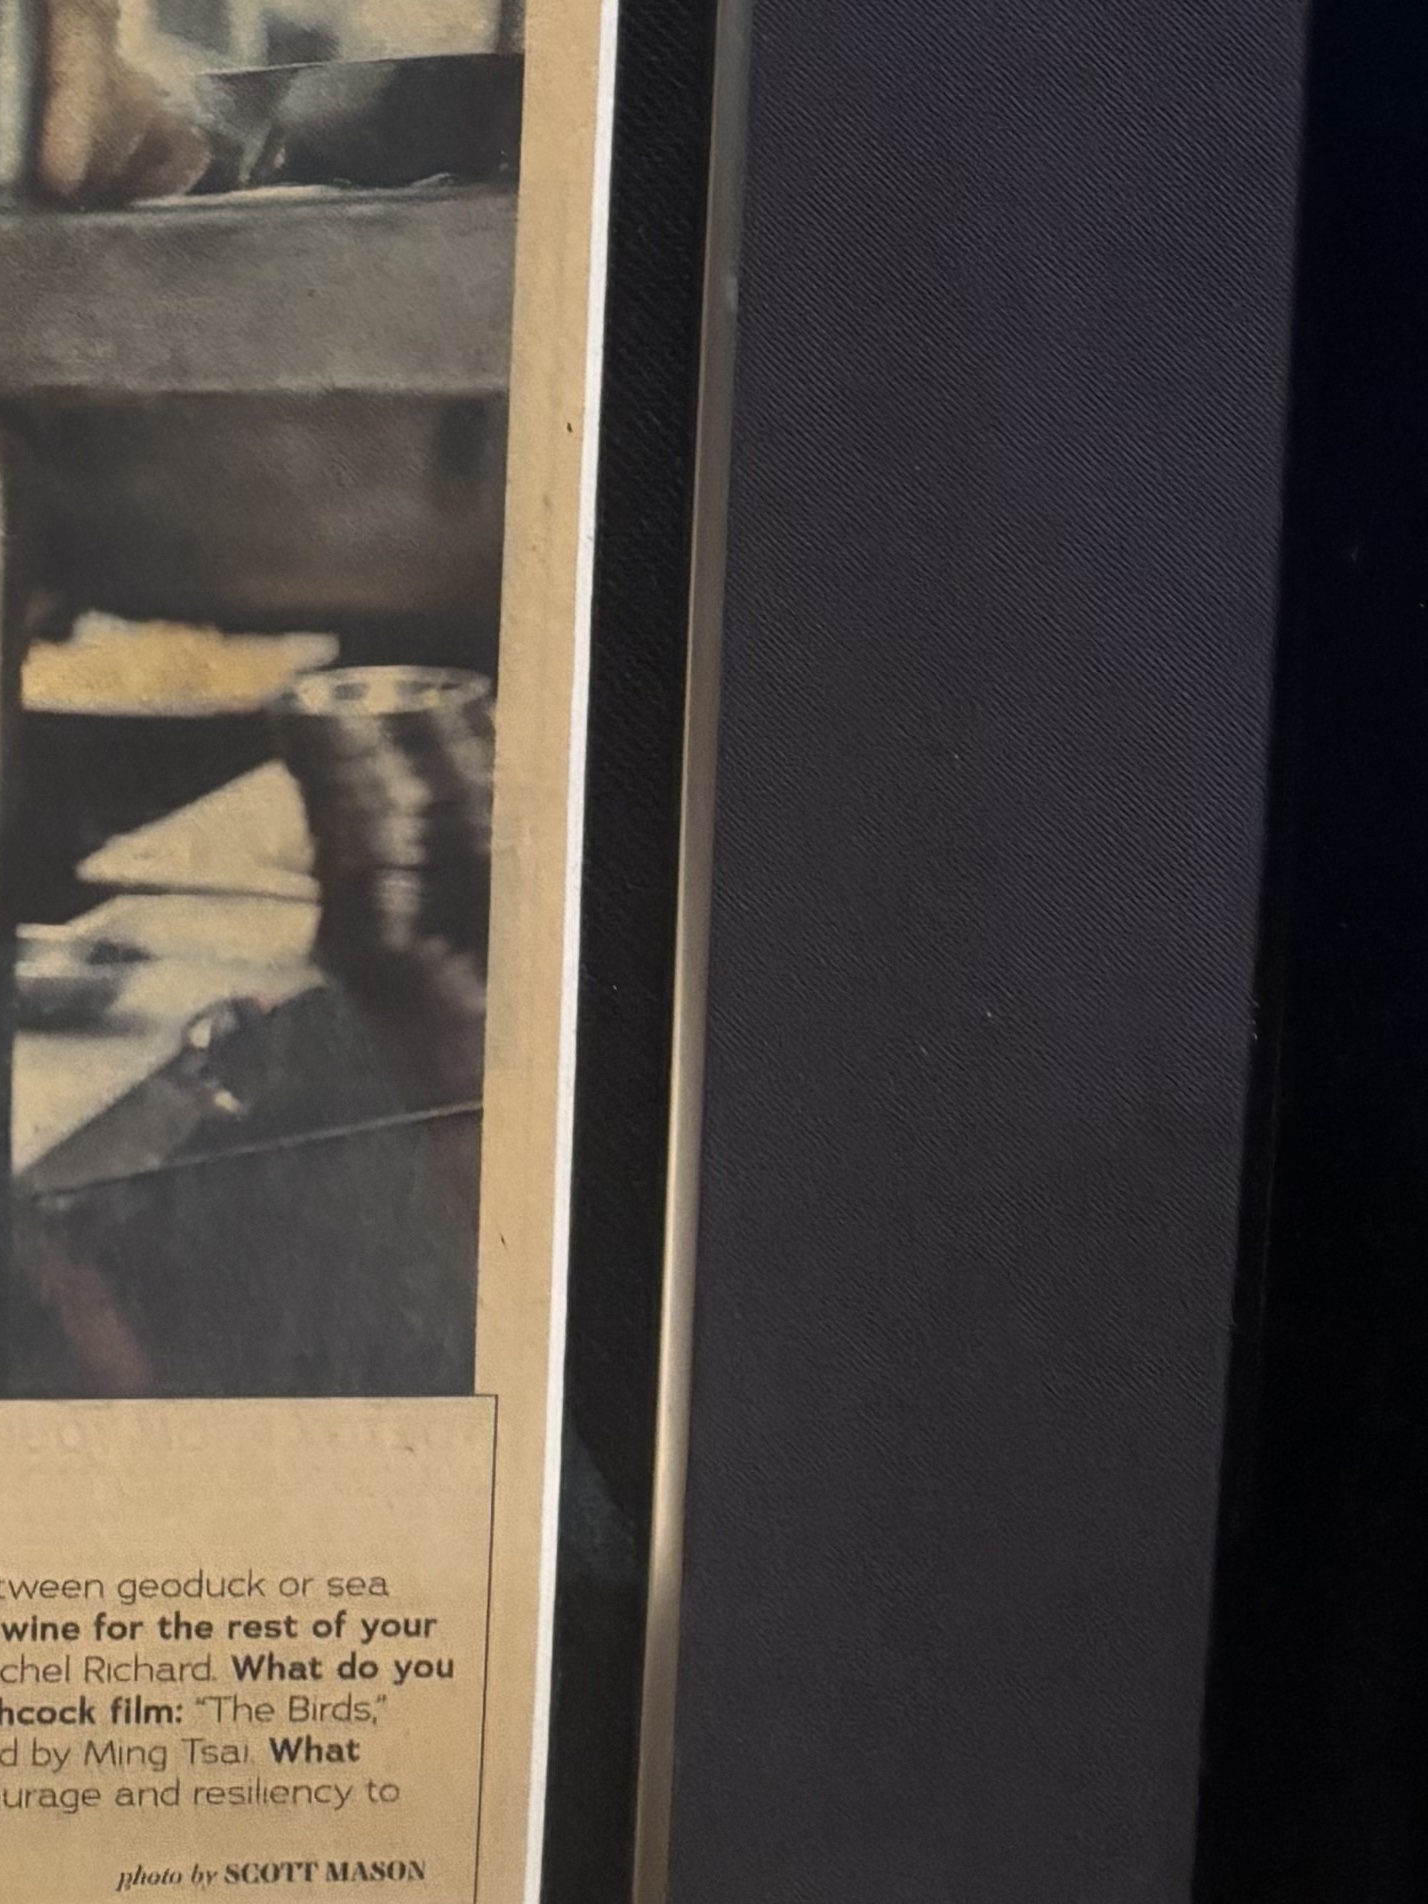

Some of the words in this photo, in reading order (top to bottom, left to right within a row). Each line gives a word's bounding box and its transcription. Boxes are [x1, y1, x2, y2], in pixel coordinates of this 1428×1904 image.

[116, 1567, 266, 1605] geoduck
[278, 1576, 314, 1598] or
[326, 1576, 390, 1599] sea
[114, 1863, 184, 1893] photo
[190, 1862, 219, 1892] by
[222, 1860, 320, 1886] SCOTT
[324, 1859, 426, 1883] MASON
